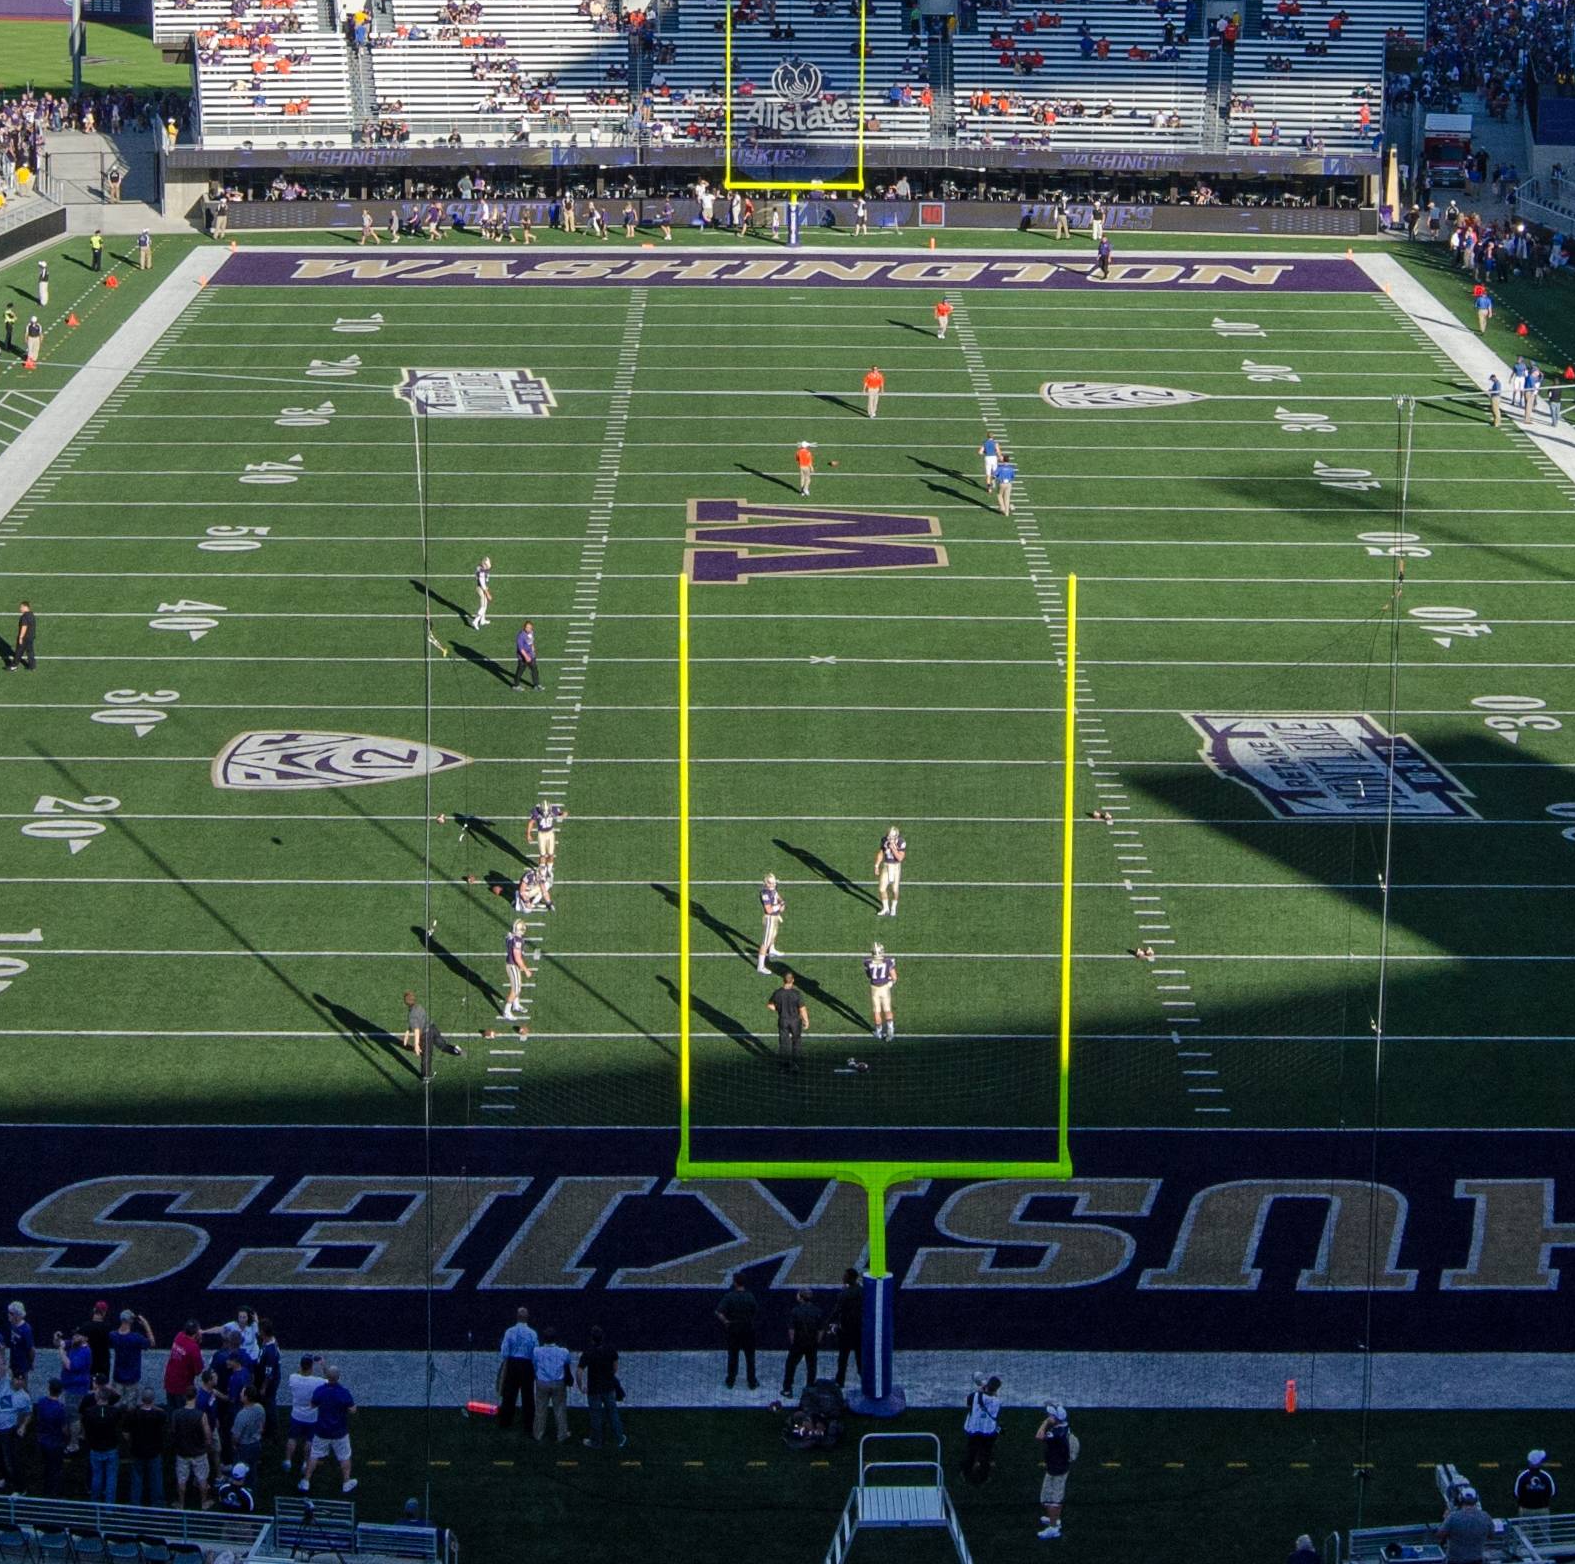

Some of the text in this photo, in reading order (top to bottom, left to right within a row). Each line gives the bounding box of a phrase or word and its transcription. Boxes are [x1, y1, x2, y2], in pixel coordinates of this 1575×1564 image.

[747, 96, 848, 131] Allstate
[287, 149, 412, 166] WASHINGTON
[1060, 153, 1185, 173] WASHINGTON
[290, 258, 1293, 286] WASHINGTON
[332, 317, 383, 332] 10
[305, 358, 362, 376] 20
[1241, 364, 1302, 383] 20
[274, 406, 336, 426] 30
[1274, 412, 1337, 433] 30
[238, 463, 304, 484] 40
[1314, 467, 1381, 492] 40
[197, 525, 271, 551] 50
[684, 498, 948, 584] W
[1356, 531, 1431, 558] 50
[148, 599, 227, 631] 40
[1408, 606, 1493, 637] 40
[90, 688, 181, 727] 30
[1470, 695, 1562, 731] 30
[351, 748, 419, 769] 12
[1249, 740, 1312, 788] RETAKE
[1264, 721, 1421, 810] MONTLAKE
[21, 795, 121, 842] 20
[869, 963, 884, 979] 77
